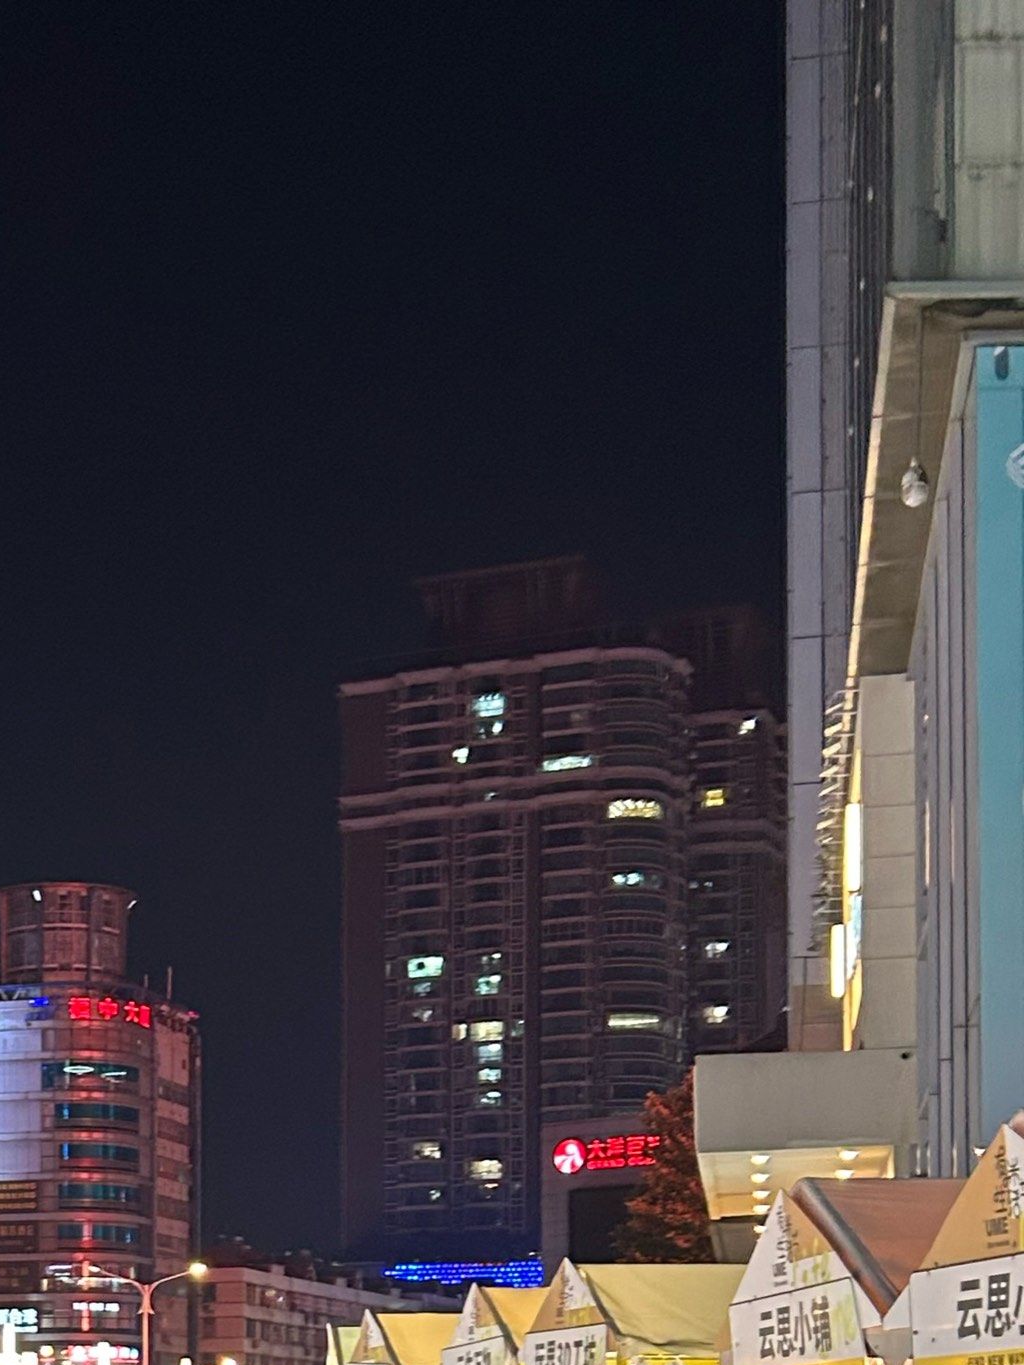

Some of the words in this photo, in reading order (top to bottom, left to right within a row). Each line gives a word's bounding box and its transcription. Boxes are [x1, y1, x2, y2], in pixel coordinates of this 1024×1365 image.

[587, 1135, 660, 1159] 大洋百
[759, 1295, 833, 1359] 云思小铺
